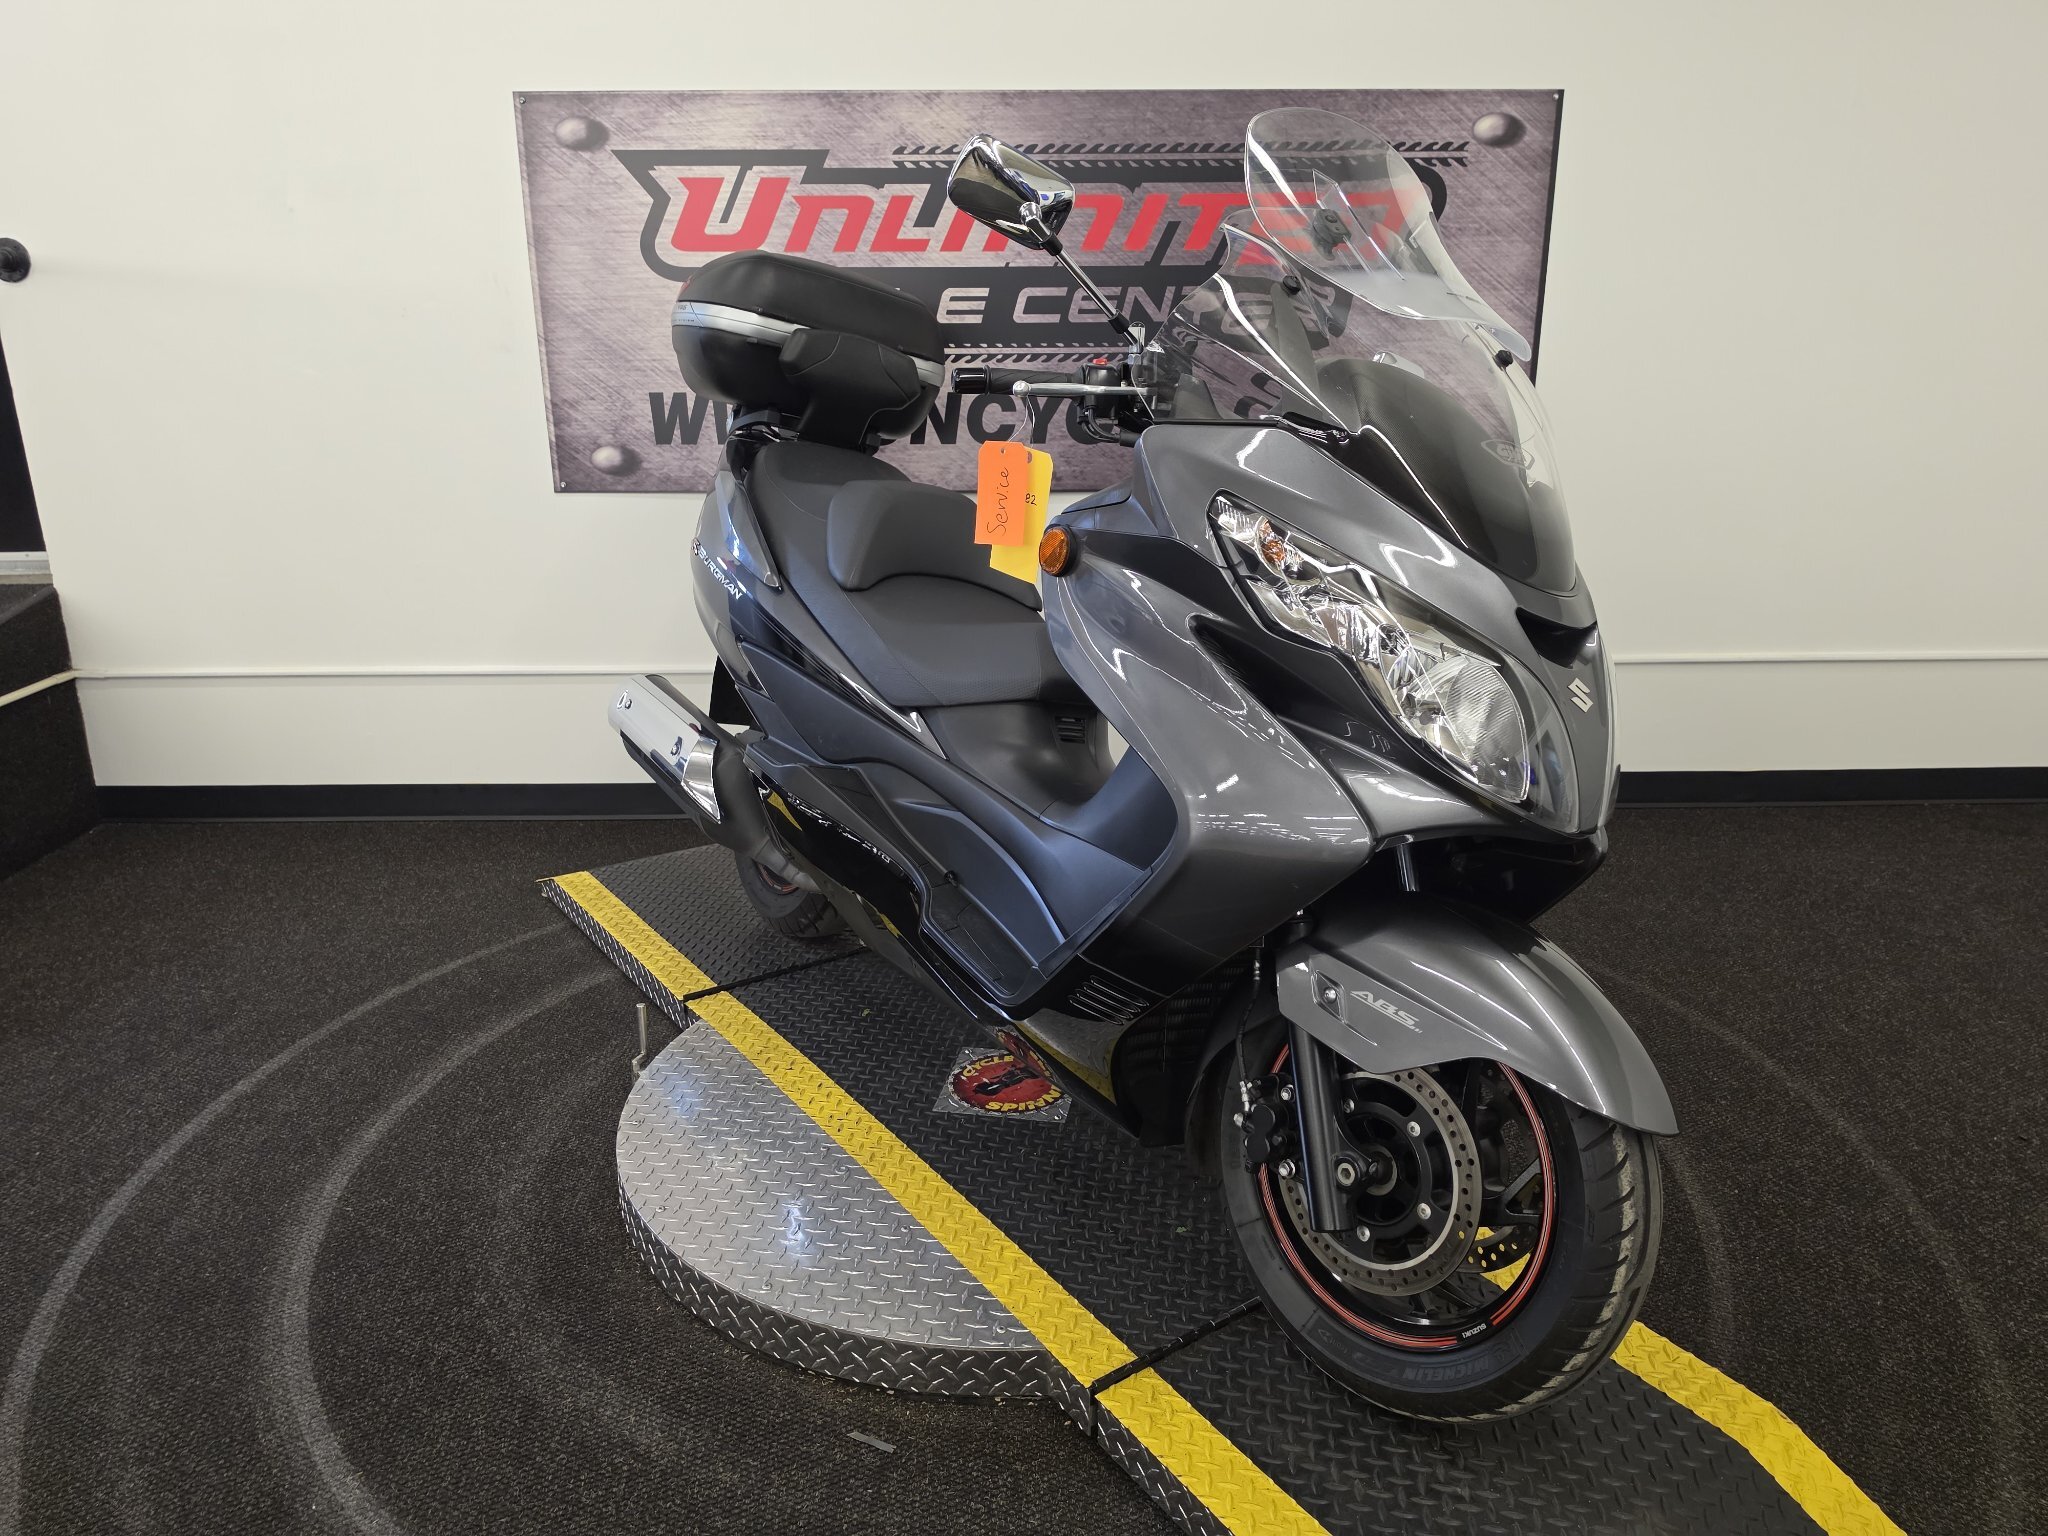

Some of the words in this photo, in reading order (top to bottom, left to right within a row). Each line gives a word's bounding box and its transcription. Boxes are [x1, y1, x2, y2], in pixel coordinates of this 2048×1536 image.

[987, 467, 1009, 536] Service
[698, 545, 743, 600] BURGMAN
[1350, 991, 1420, 1027] ABS
[962, 1054, 1015, 1077] CYCLE
[1461, 1322, 1487, 1340] SUZUKI
[1402, 1354, 1490, 1382] MICHELIN
